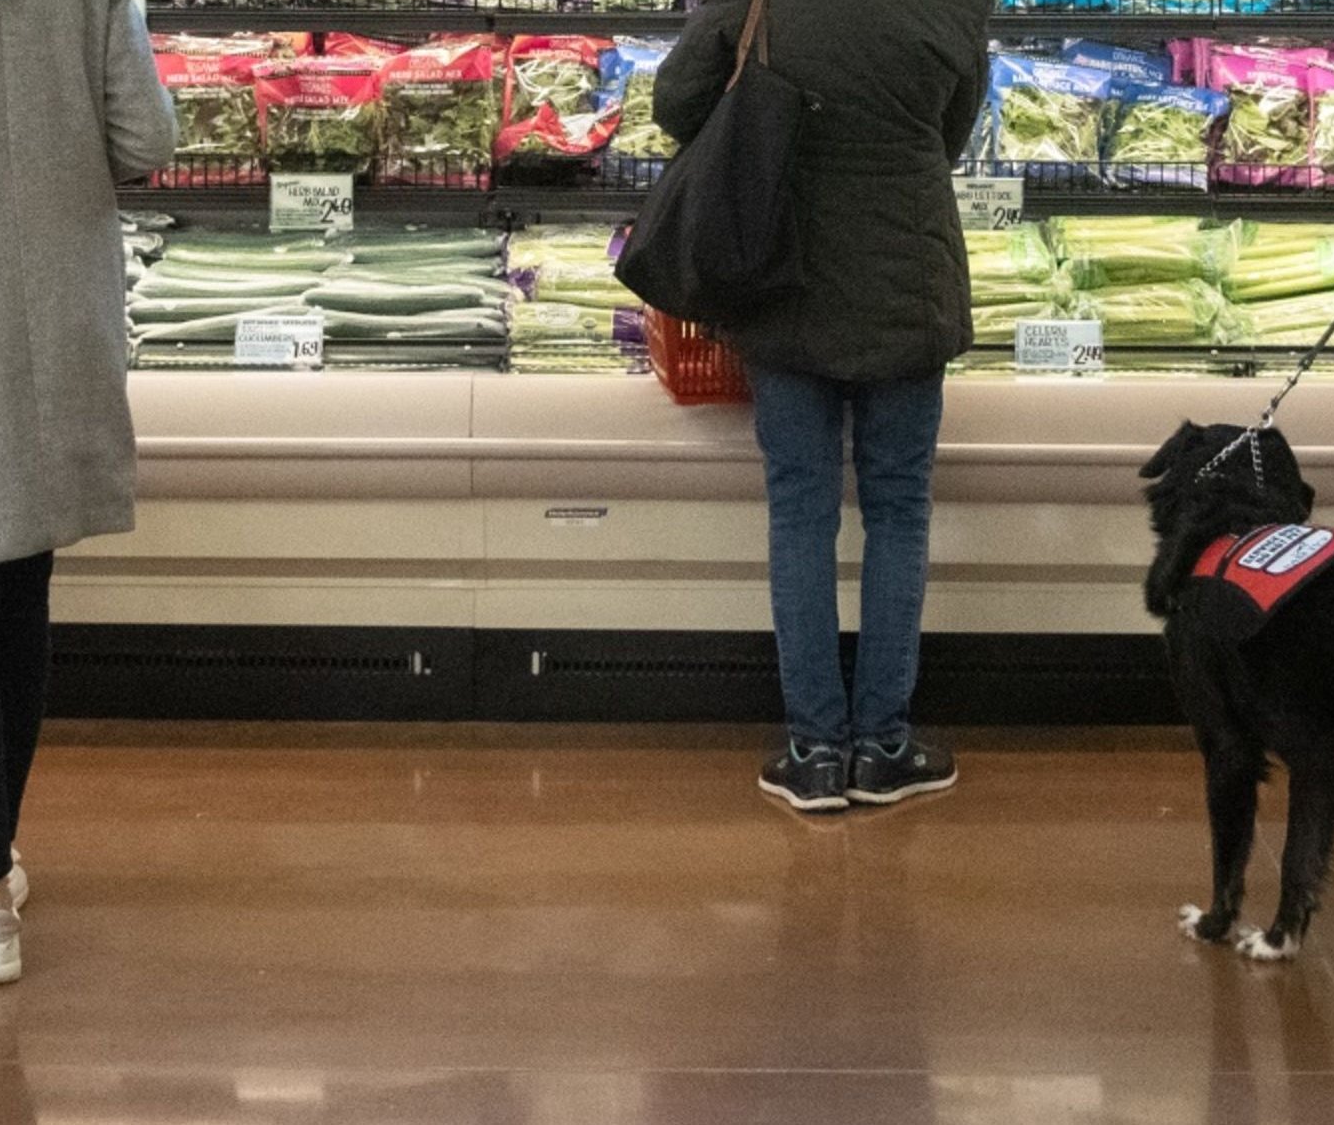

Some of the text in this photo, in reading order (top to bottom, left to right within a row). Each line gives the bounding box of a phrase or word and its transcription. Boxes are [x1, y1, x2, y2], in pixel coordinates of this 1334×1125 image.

[287, 186, 340, 197] HERB SALAD
[302, 197, 321, 207] MIX
[970, 201, 988, 212] MIX
[1024, 325, 1067, 336] CELERY
[237, 334, 293, 343] CUCUMBERS
[1024, 336, 1069, 347] HEARTS
